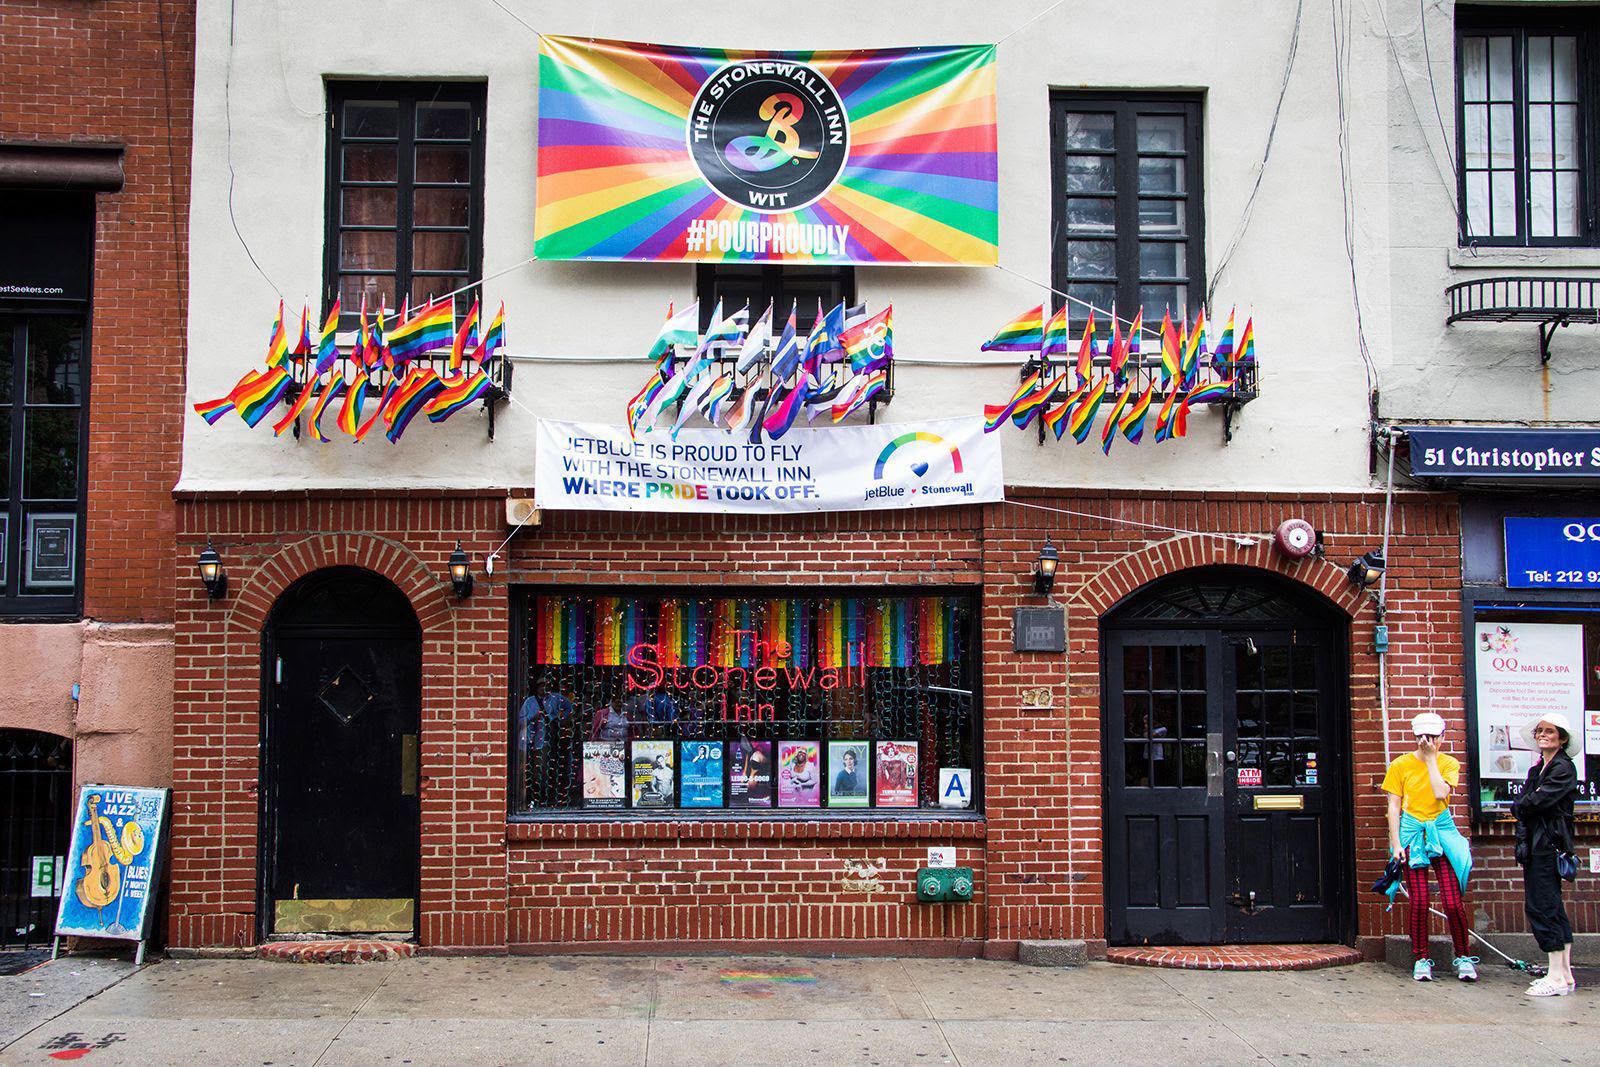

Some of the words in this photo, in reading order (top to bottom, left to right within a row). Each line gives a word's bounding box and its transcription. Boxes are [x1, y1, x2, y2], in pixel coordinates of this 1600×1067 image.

[694, 100, 715, 143] THE
[709, 62, 827, 105] STONEWALL
[824, 105, 843, 145] INN
[748, 190, 789, 207] WIT
[686, 219, 850, 256] #POURPROUDLY
[564, 437, 645, 457] JETBLUE
[650, 444, 667, 460] IS
[672, 445, 737, 461] PROUD
[742, 445, 766, 461] TO
[771, 445, 803, 461] FLY
[1423, 447, 1446, 466] 51
[1451, 446, 1586, 471] Christopher
[563, 456, 610, 475] WITH
[615, 461, 653, 478] THE
[656, 465, 773, 483] STONEWALL
[563, 477, 641, 498] WHERE
[645, 482, 709, 500] PRIDE
[713, 485, 771, 500] TOOK
[774, 485, 820, 500] OFF.
[864, 485, 906, 501] jetBlue
[921, 483, 973, 495] Stonewall
[1525, 570, 1552, 583] Tel:
[1556, 570, 1583, 583] 212
[725, 629, 792, 658] The
[627, 641, 866, 691] Stonewall
[1492, 657, 1518, 672] QQ
[1521, 665, 1545, 673] NAILS
[1546, 665, 1553, 673] &
[1554, 665, 1570, 673] SPA
[721, 693, 775, 722] Inn
[1239, 769, 1260, 777] ATM
[944, 773, 966, 797] A
[105, 792, 132, 804] LIVE
[103, 804, 136, 816] JAZZ
[116, 818, 123, 827] &
[127, 865, 149, 880] BLUES
